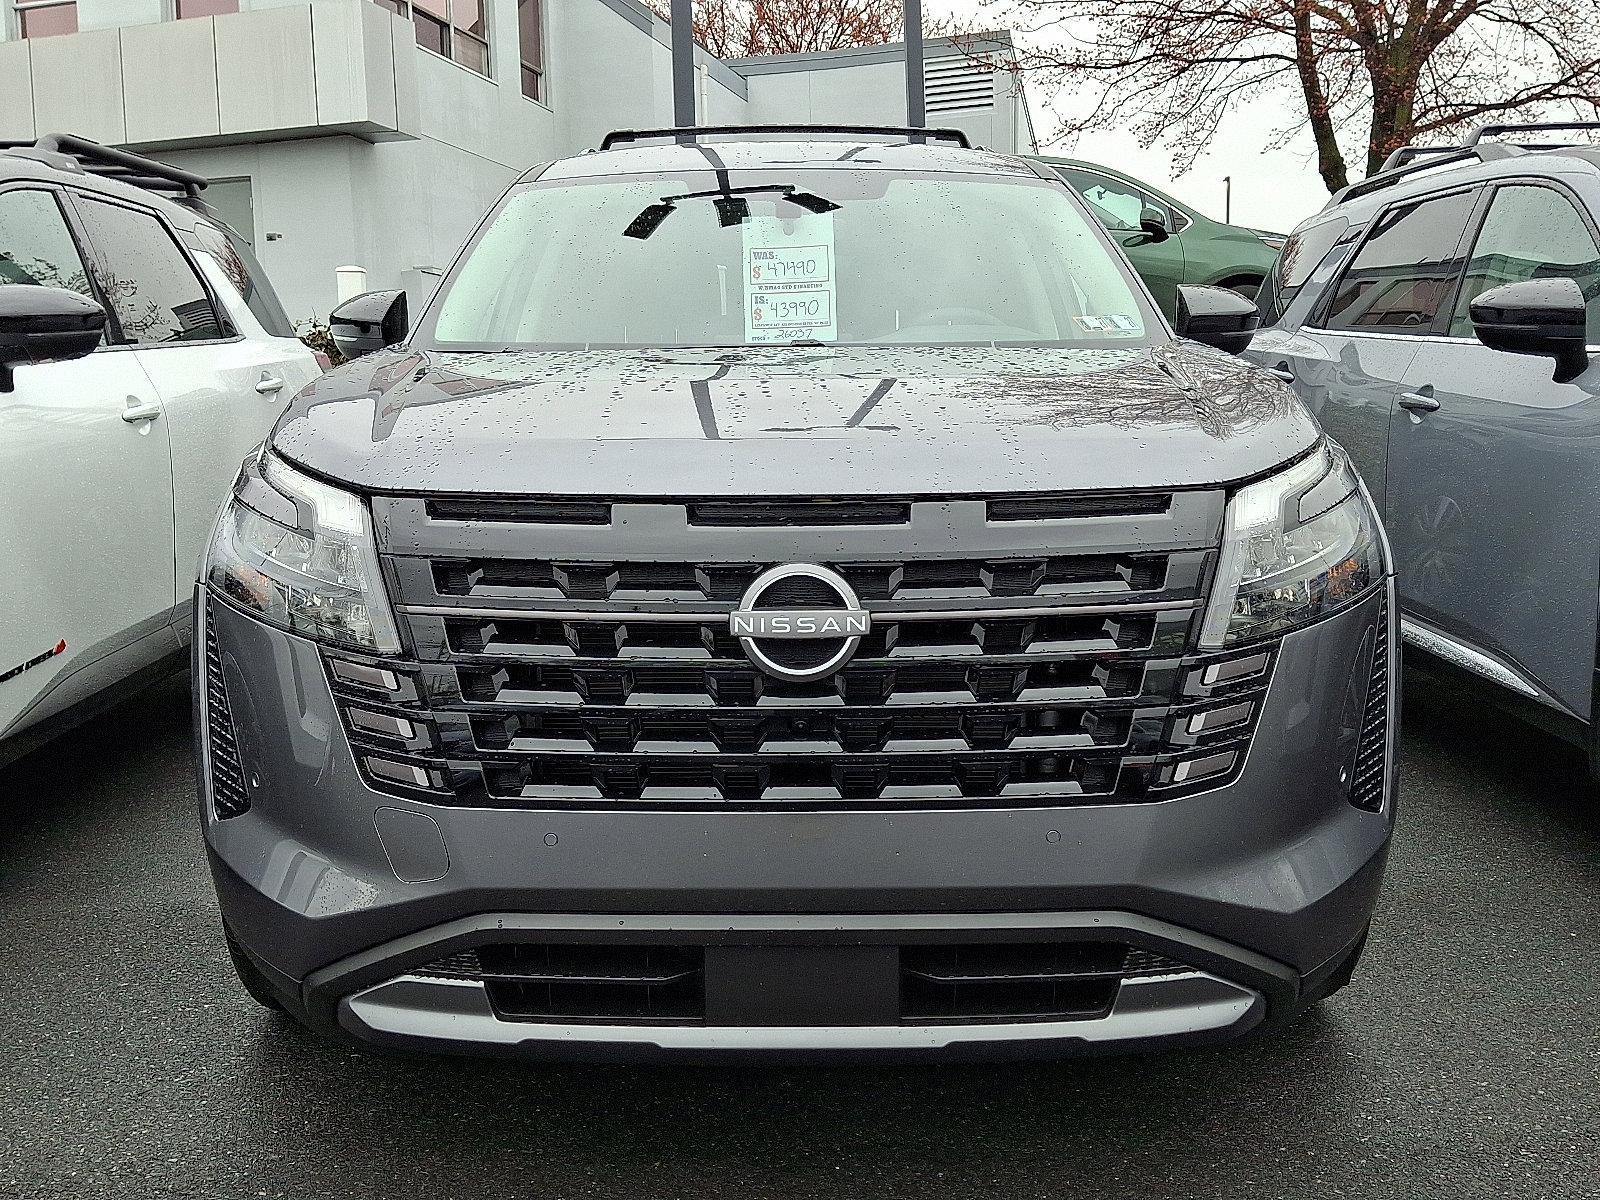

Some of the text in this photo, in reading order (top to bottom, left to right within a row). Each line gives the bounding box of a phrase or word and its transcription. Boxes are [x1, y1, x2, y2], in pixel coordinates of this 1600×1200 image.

[753, 251, 778, 260] WAS:
[752, 260, 816, 280] $ 47490
[754, 295, 769, 304] IS:
[770, 299, 819, 318] 43990
[774, 329, 813, 340] 26037
[734, 615, 866, 633] NISSAN
